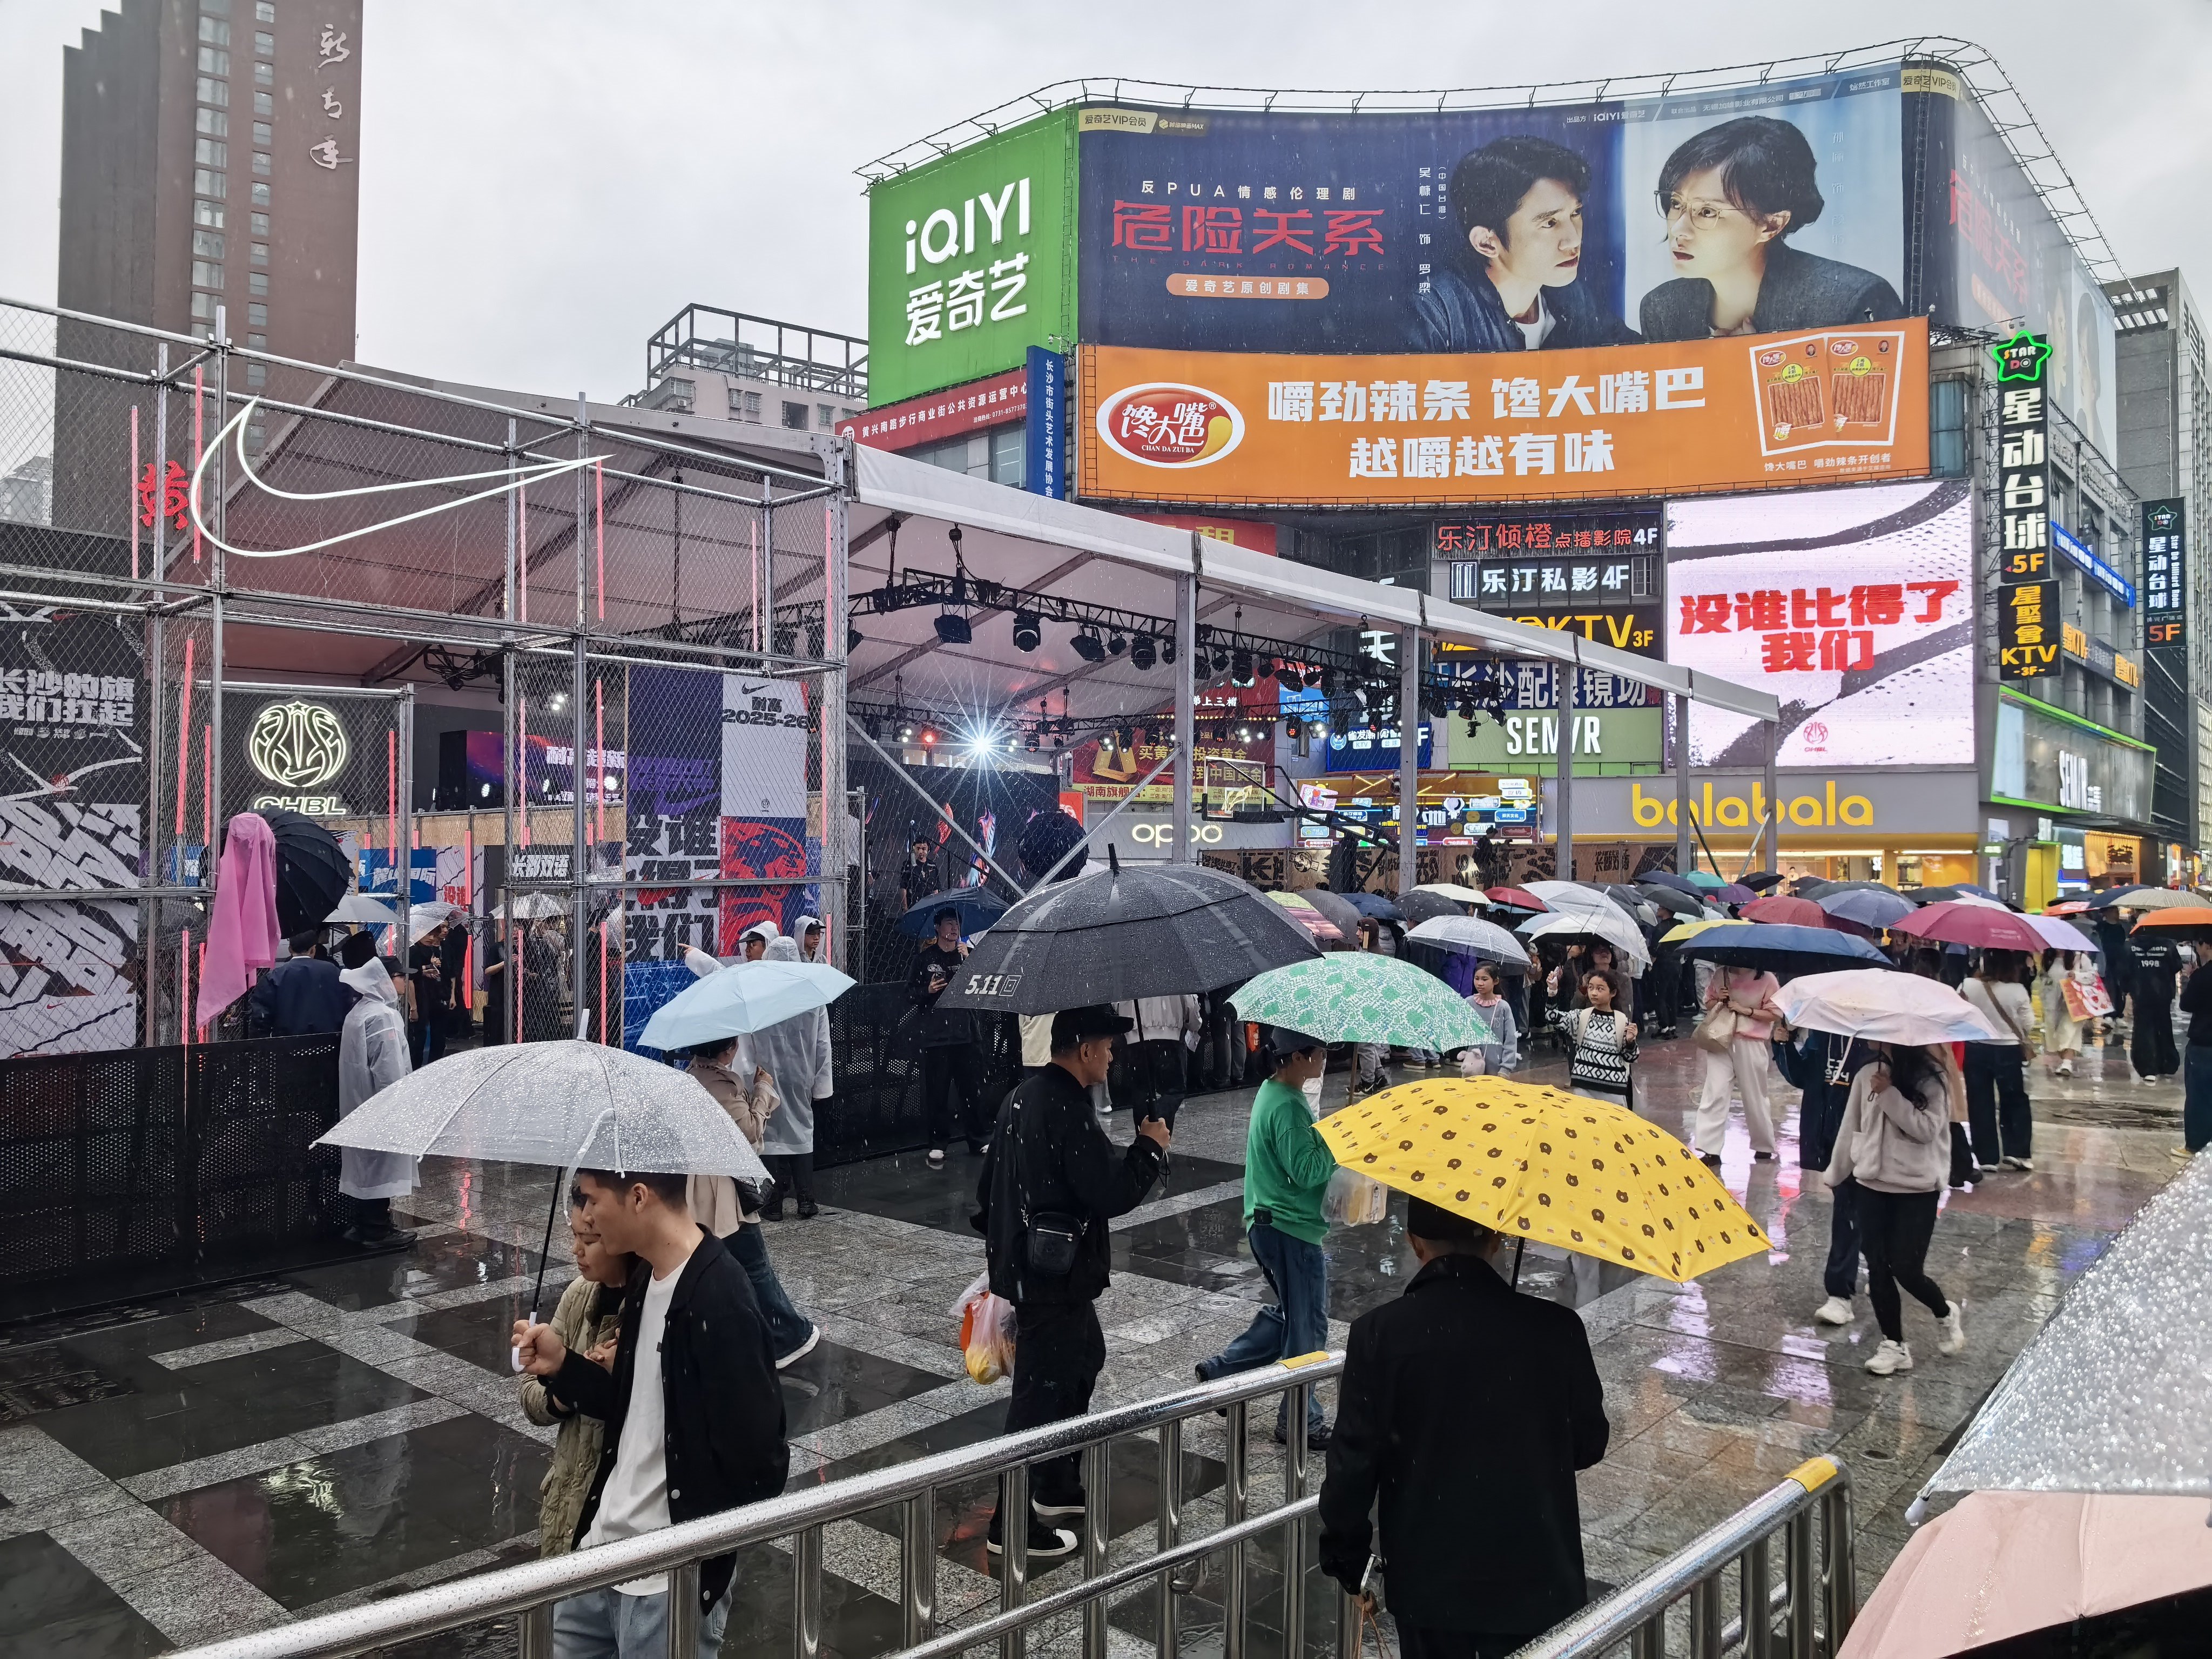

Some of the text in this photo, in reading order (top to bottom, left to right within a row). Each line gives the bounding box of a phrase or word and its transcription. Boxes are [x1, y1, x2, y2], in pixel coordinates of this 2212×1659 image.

[1085, 114, 1146, 127] 爱奇艺VIP会员
[1141, 180, 1356, 200] 反PUA情感伦理剧
[906, 177, 1031, 275] iQIYI
[1112, 199, 1386, 256] 危险关系
[1419, 233, 1431, 245] 饰
[1185, 279, 1310, 295] 爱奇艺原创剧集
[905, 252, 1030, 346] 爱奇艺
[2004, 346, 2036, 360] STAR
[1267, 366, 1706, 422] 嚼劲辣条 馋大嘴巴
[862, 382, 1027, 439] 黄兴南路步行商业街公共资源运营中心
[1045, 359, 1054, 498] 长沙市街头艺术发展协会
[1121, 402, 1208, 447] 馋大嘴巴
[1141, 444, 1161, 453] CHAN
[1349, 429, 1616, 478] 越嚼越有味
[1764, 453, 1891, 473] 馋大嘴巴 嚼劲辣条开创者
[2001, 387, 2048, 551] 星动台球
[2011, 552, 2045, 574] 5F
[2148, 536, 2168, 609] 星动台球
[1679, 579, 1959, 635] 没谁比得了
[1633, 630, 1654, 648] 3F
[2148, 623, 2181, 642] 5F
[1762, 630, 1874, 672] 我们
[2001, 644, 2057, 666] KTV
[722, 709, 809, 729] 2025-26
[253, 796, 347, 815] CHBL
[1631, 780, 1873, 827] balabala
[2141, 960, 2160, 968] 1998
[965, 974, 1002, 995] 5.11
